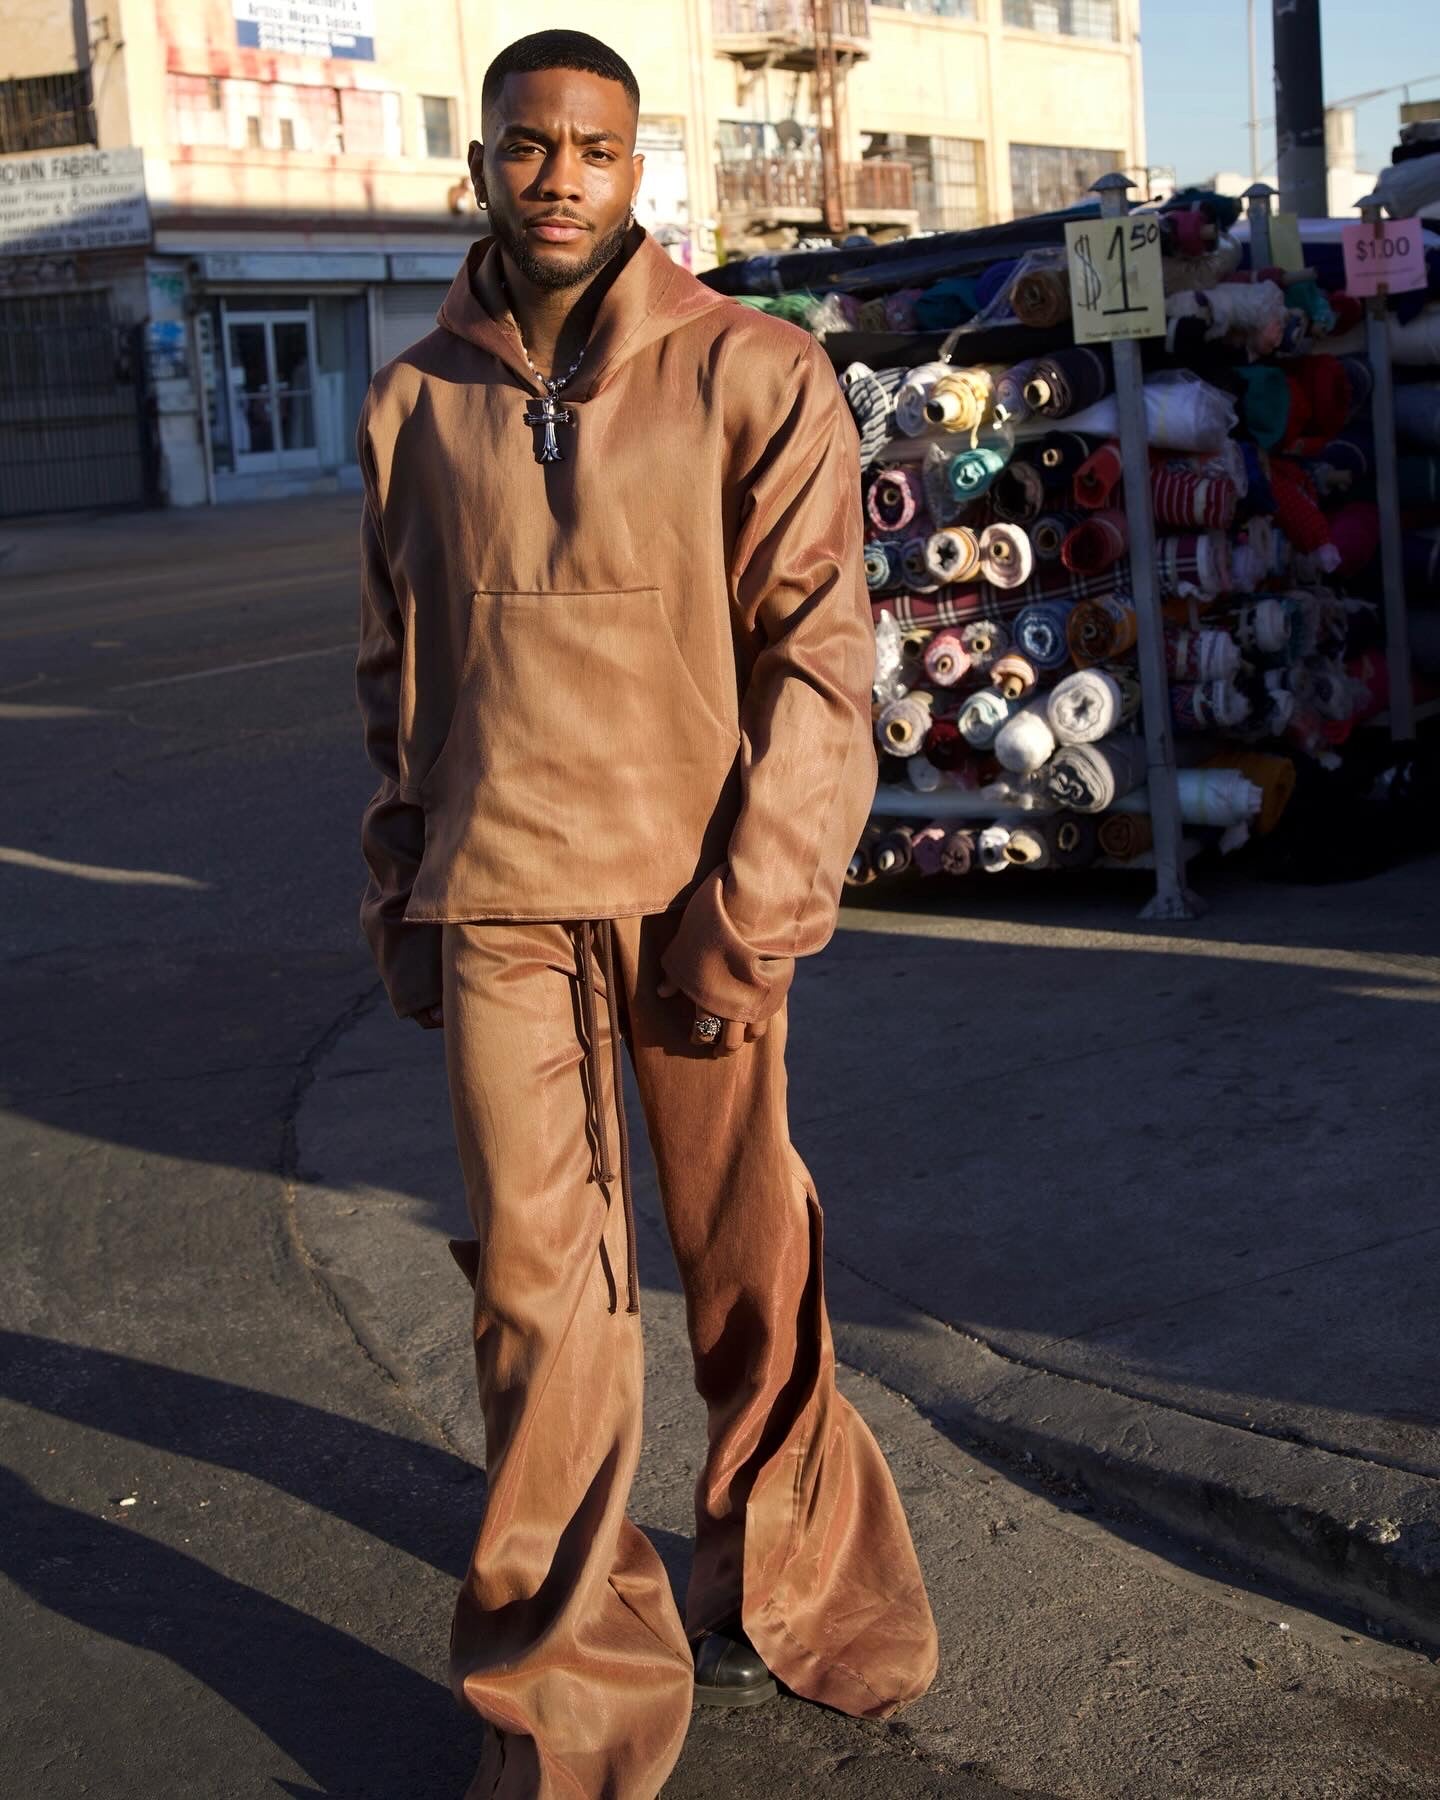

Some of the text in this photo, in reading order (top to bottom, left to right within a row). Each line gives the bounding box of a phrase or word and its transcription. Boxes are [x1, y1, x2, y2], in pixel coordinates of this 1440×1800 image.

[0, 162, 45, 185] OWN
[51, 153, 109, 178] FABRIC
[25, 188, 65, 201] Fleece
[54, 202, 62, 215] &
[1356, 236, 1410, 261] $1.00
